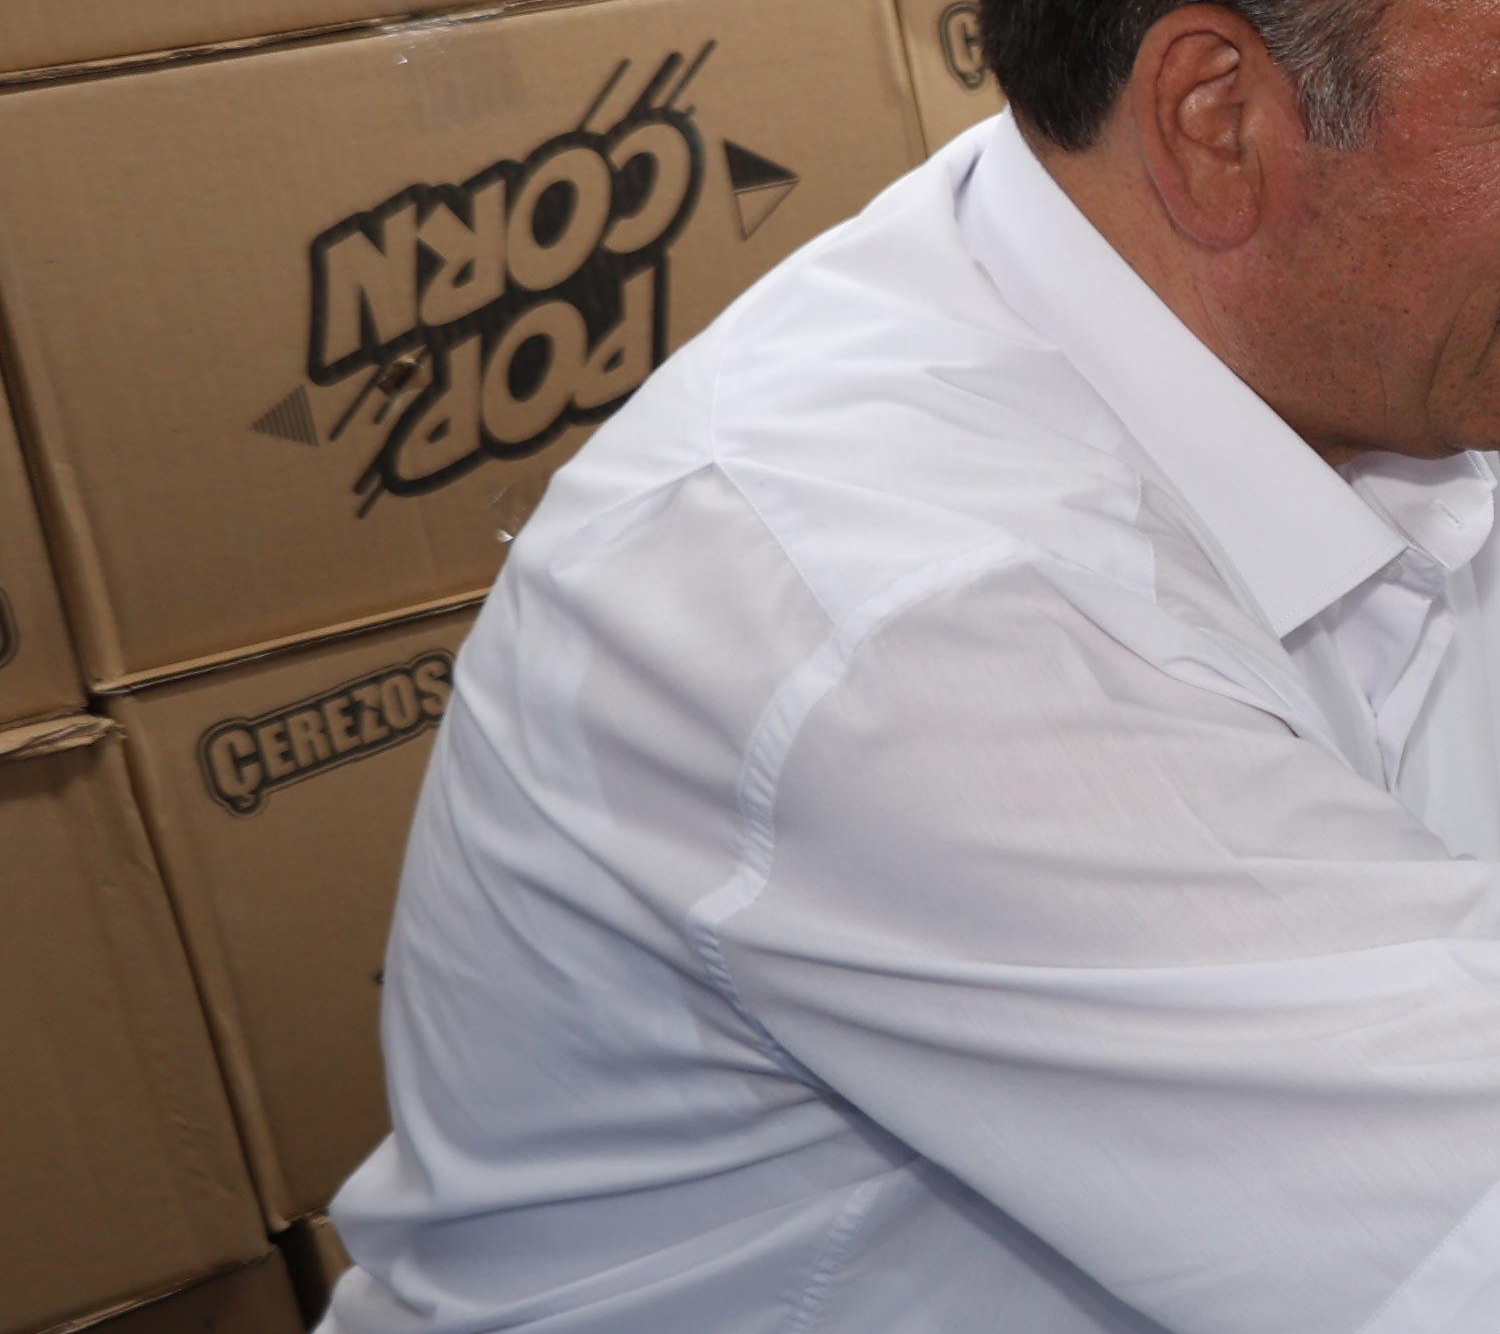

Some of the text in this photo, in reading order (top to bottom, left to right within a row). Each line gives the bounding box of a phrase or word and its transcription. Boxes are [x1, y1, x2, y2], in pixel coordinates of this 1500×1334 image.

[315, 110, 701, 377] CORN
[387, 255, 664, 491] POP
[203, 653, 456, 813] ÇEREZOS
